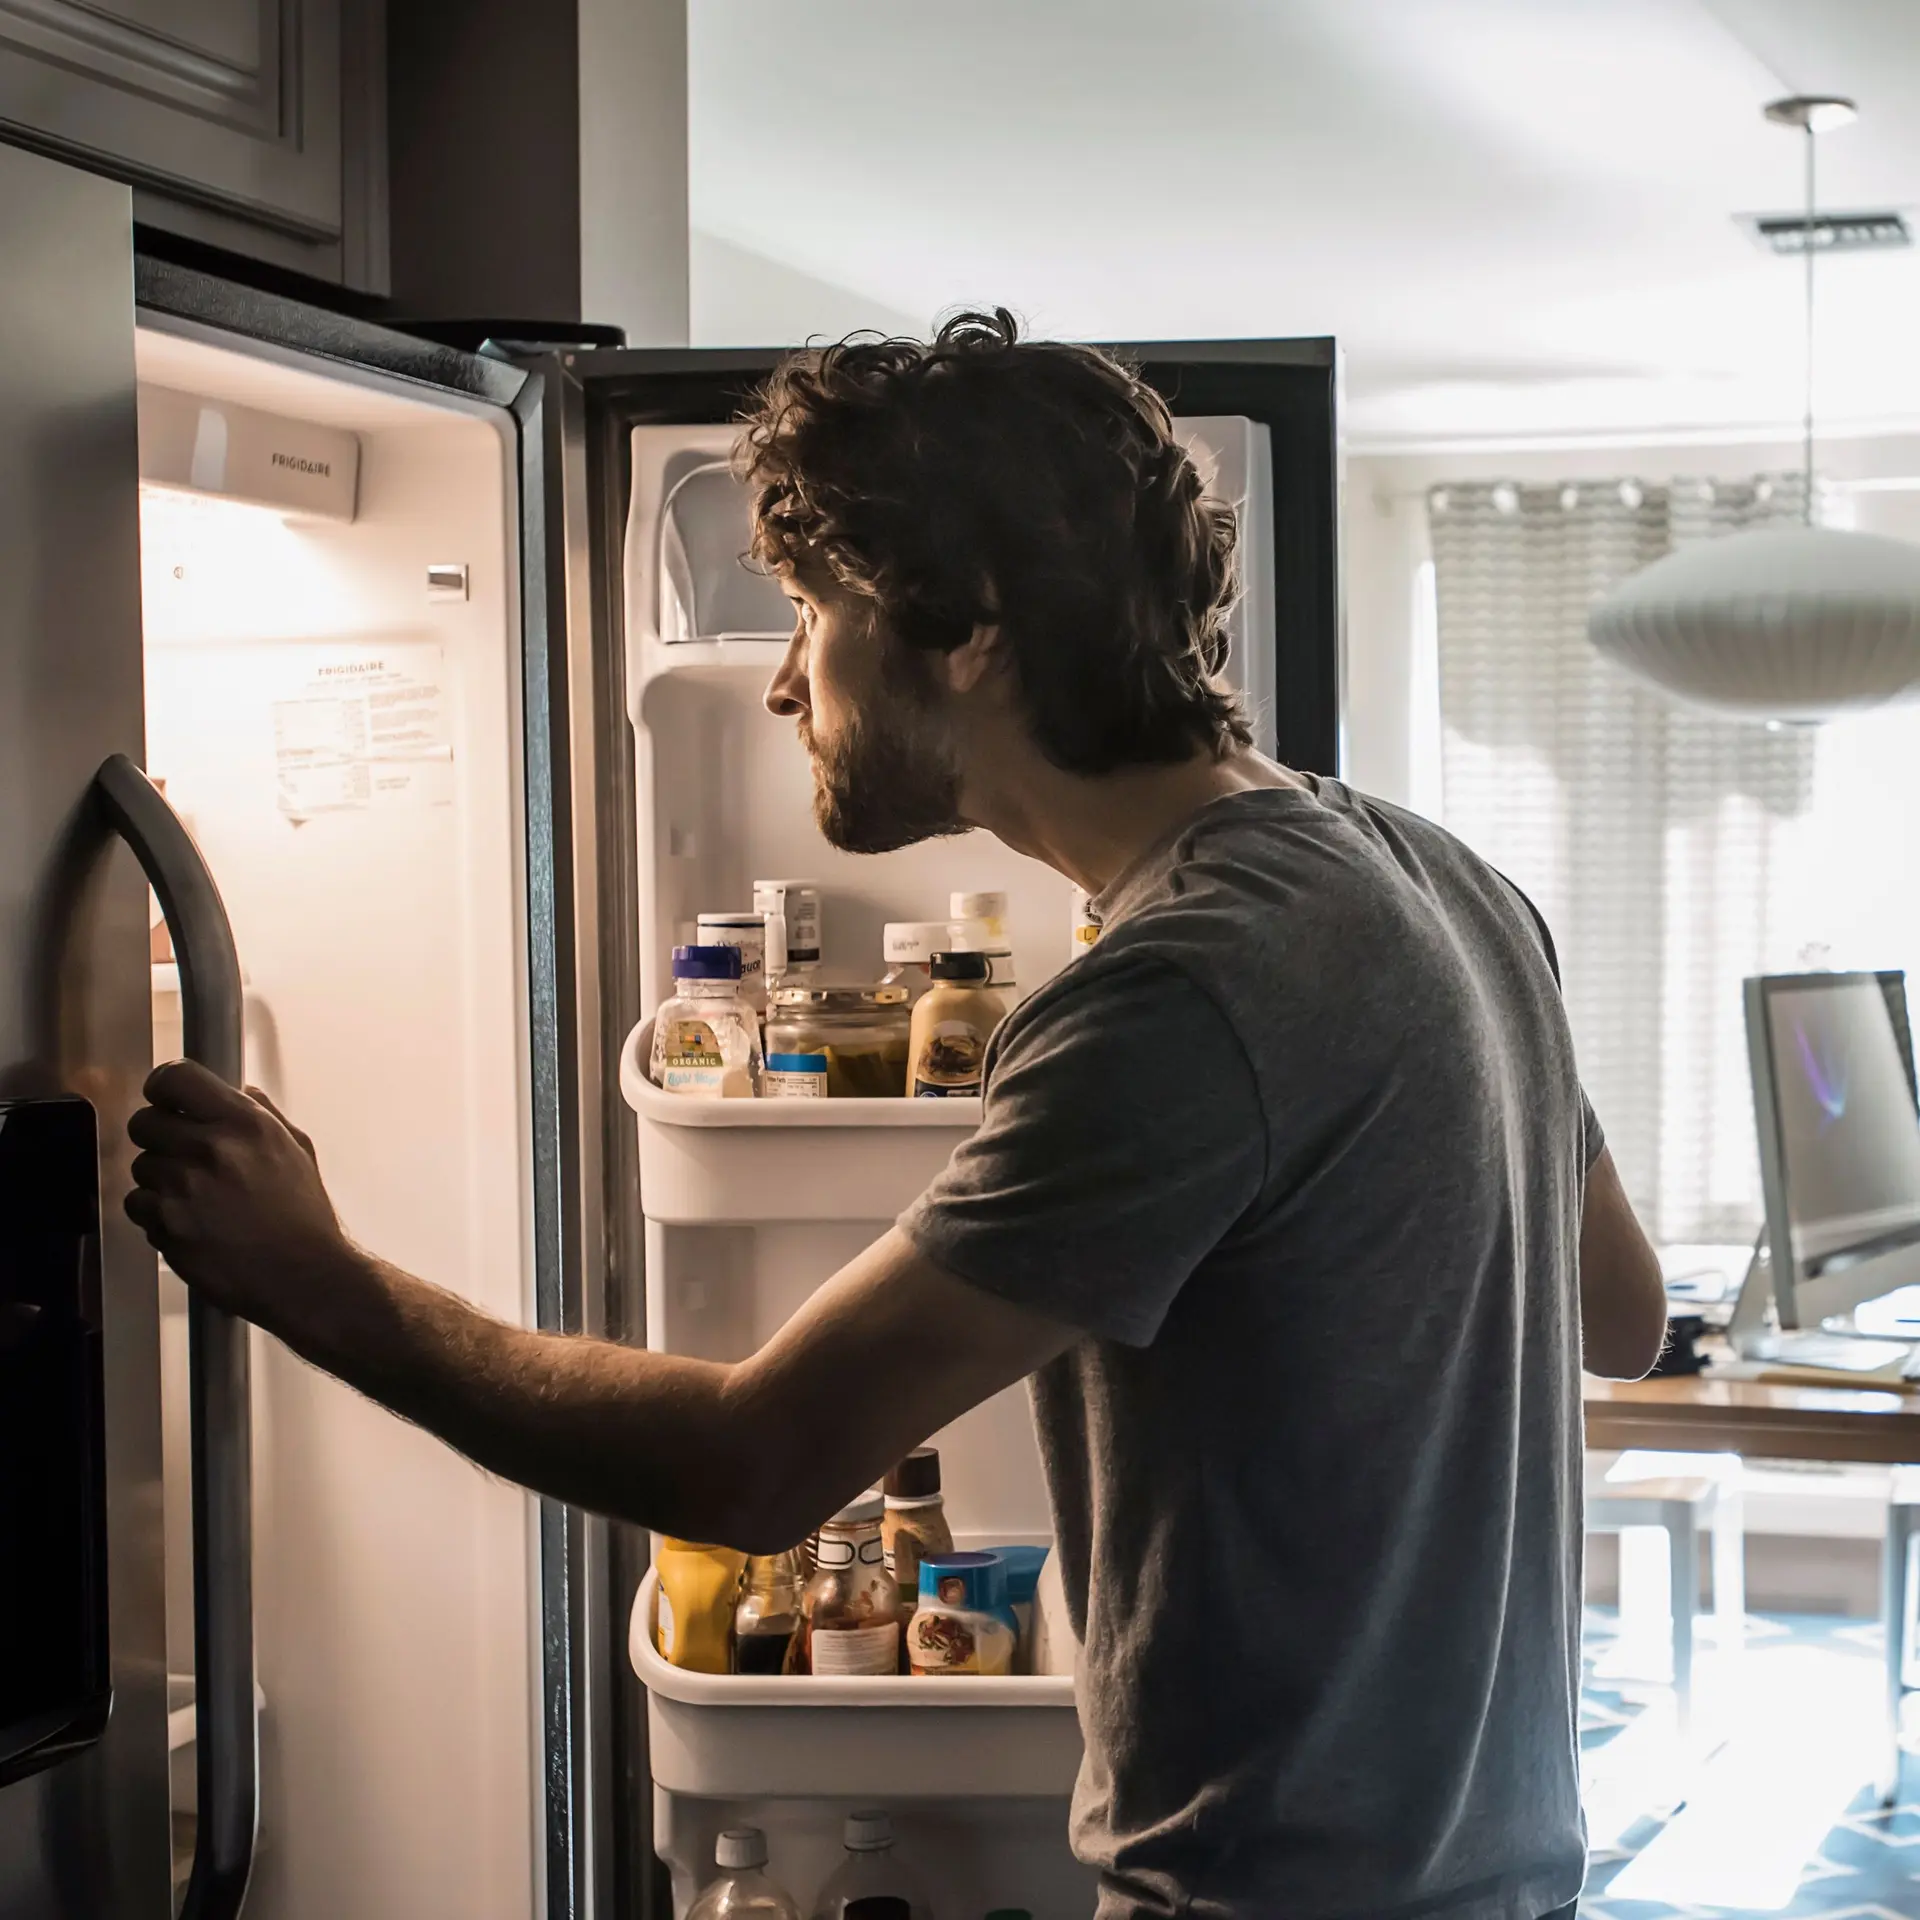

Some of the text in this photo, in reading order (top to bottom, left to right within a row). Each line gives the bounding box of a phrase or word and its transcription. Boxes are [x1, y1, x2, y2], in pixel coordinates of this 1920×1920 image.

[271, 453, 330, 478] FRIGIDAIRE
[318, 661, 385, 676] FRIGIDAIRE
[672, 1057, 716, 1066] ORGANIC
